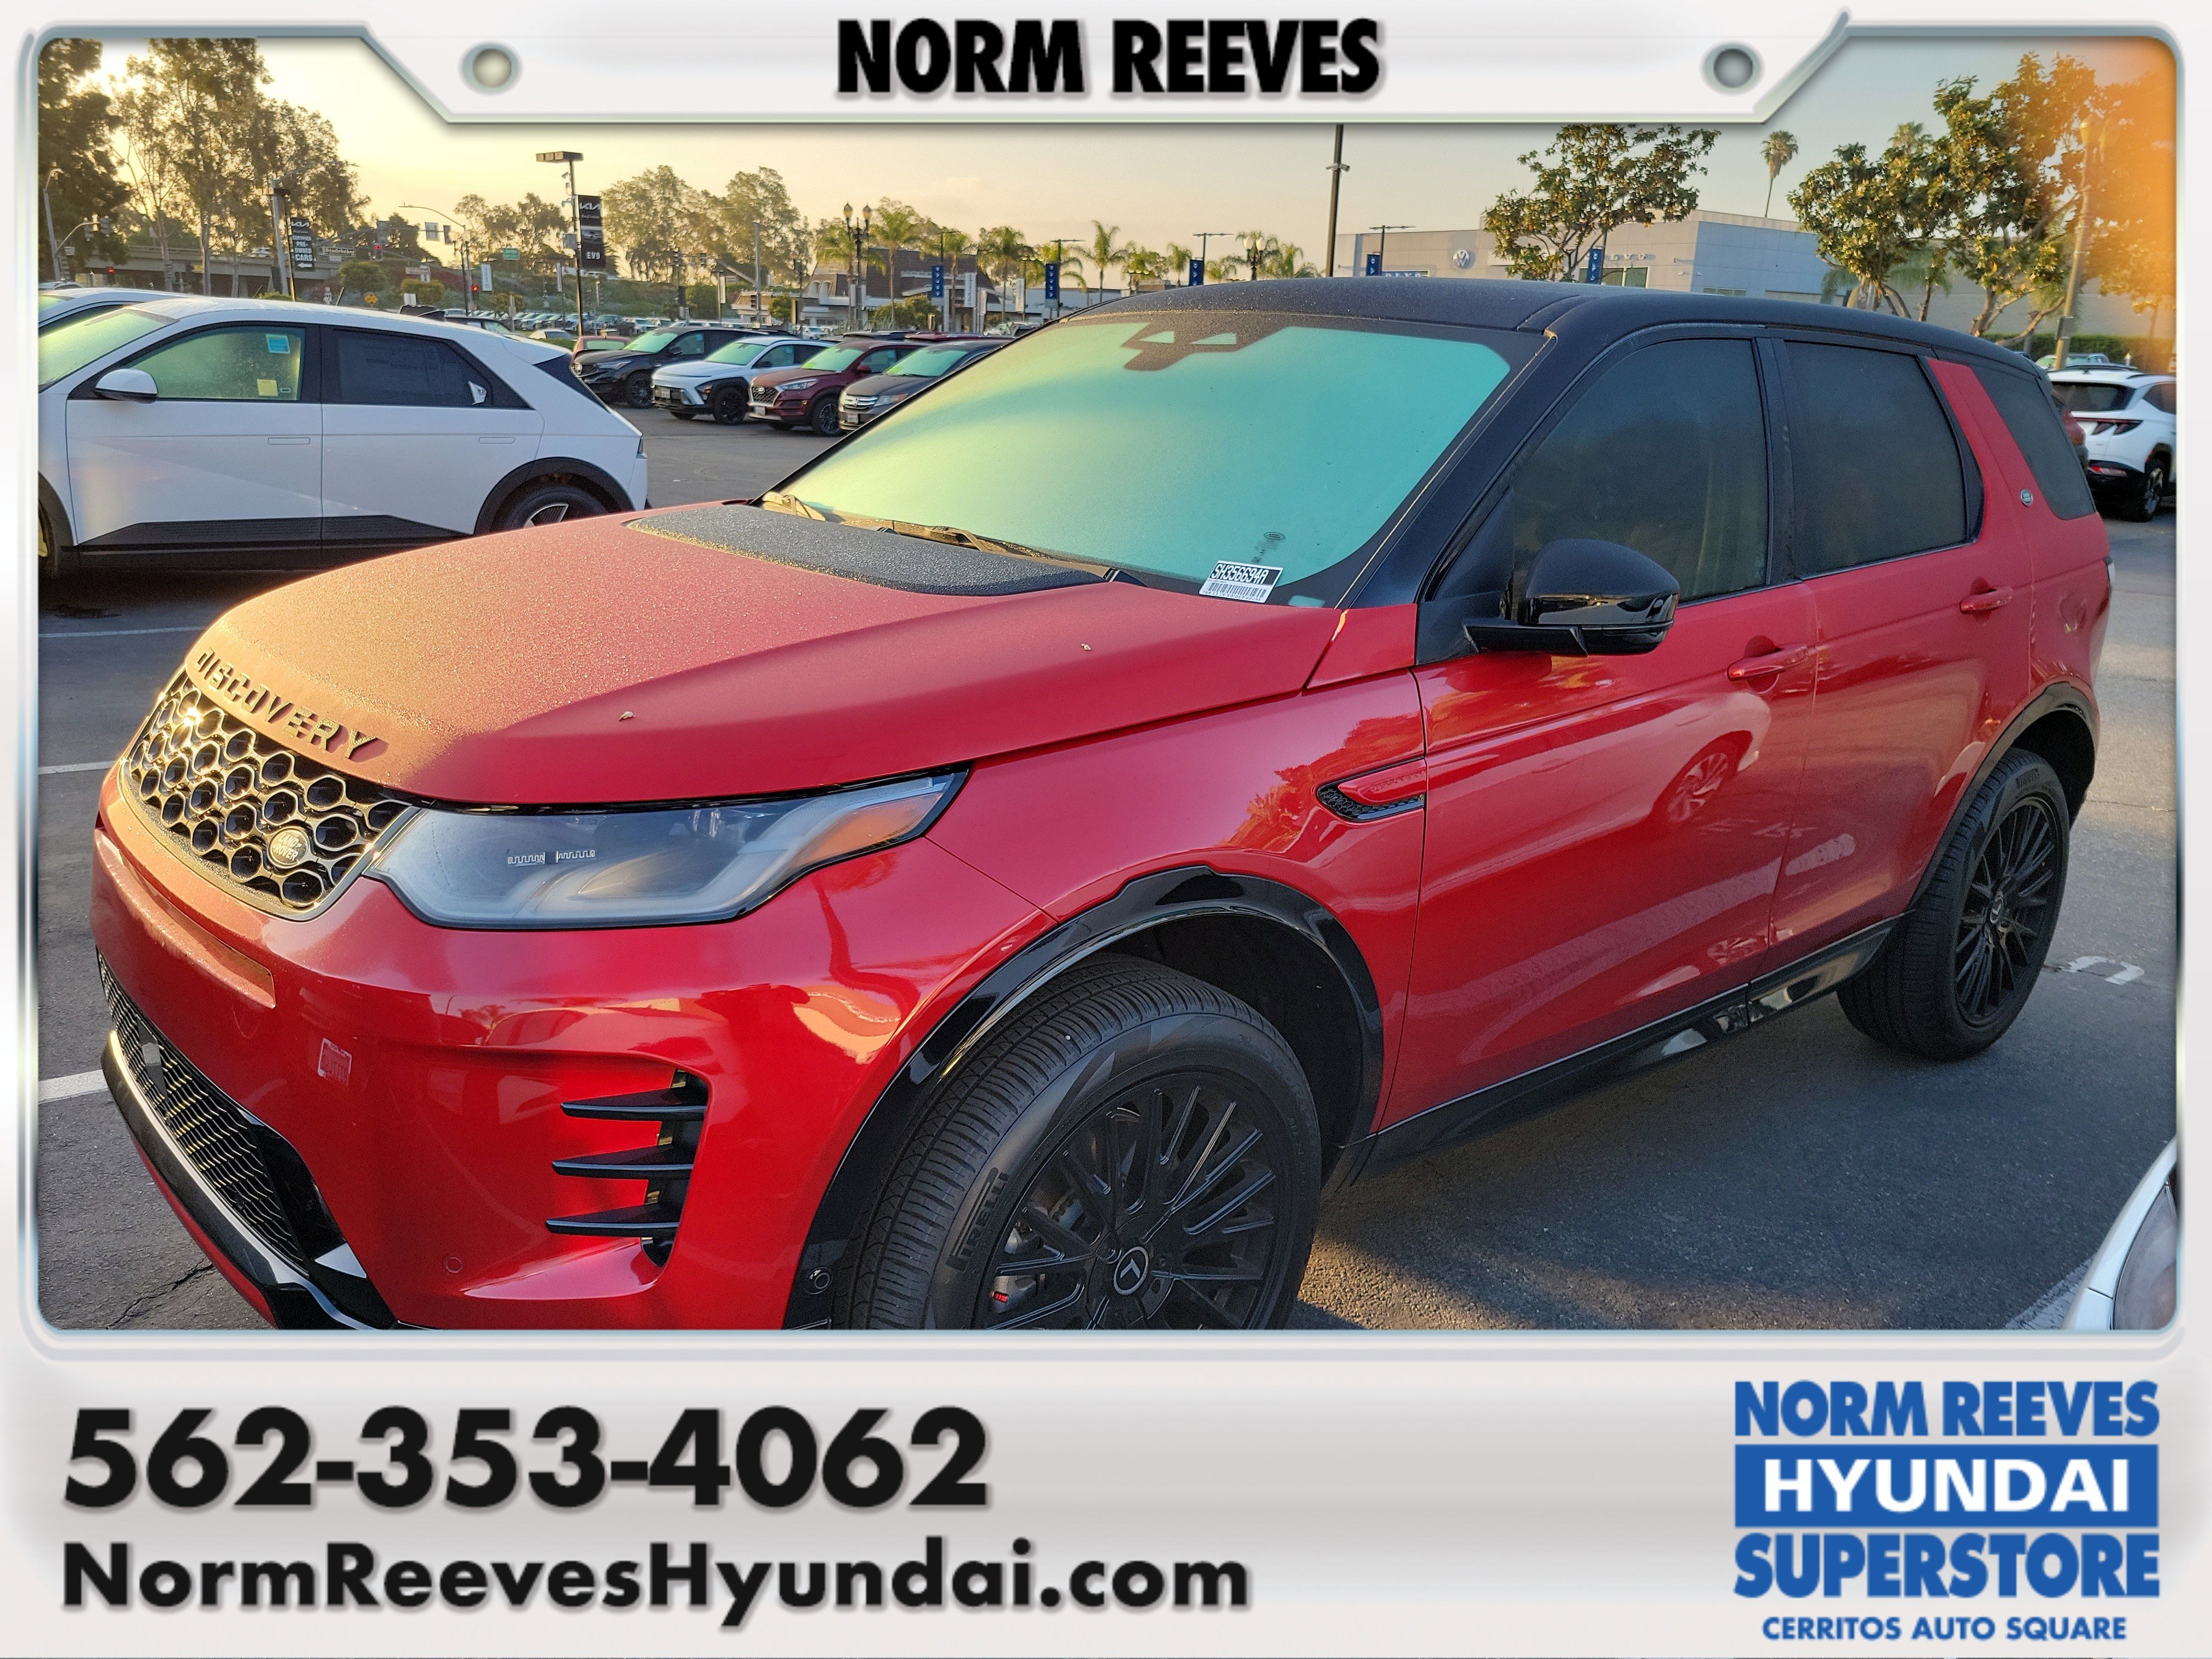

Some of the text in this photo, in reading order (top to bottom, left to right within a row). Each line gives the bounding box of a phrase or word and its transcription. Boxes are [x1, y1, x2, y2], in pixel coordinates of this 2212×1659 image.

[1211, 563, 1269, 585] SH356694A
[197, 647, 377, 760] DISCOVERY
[278, 833, 300, 847] LAND
[273, 844, 299, 861] ROVER
